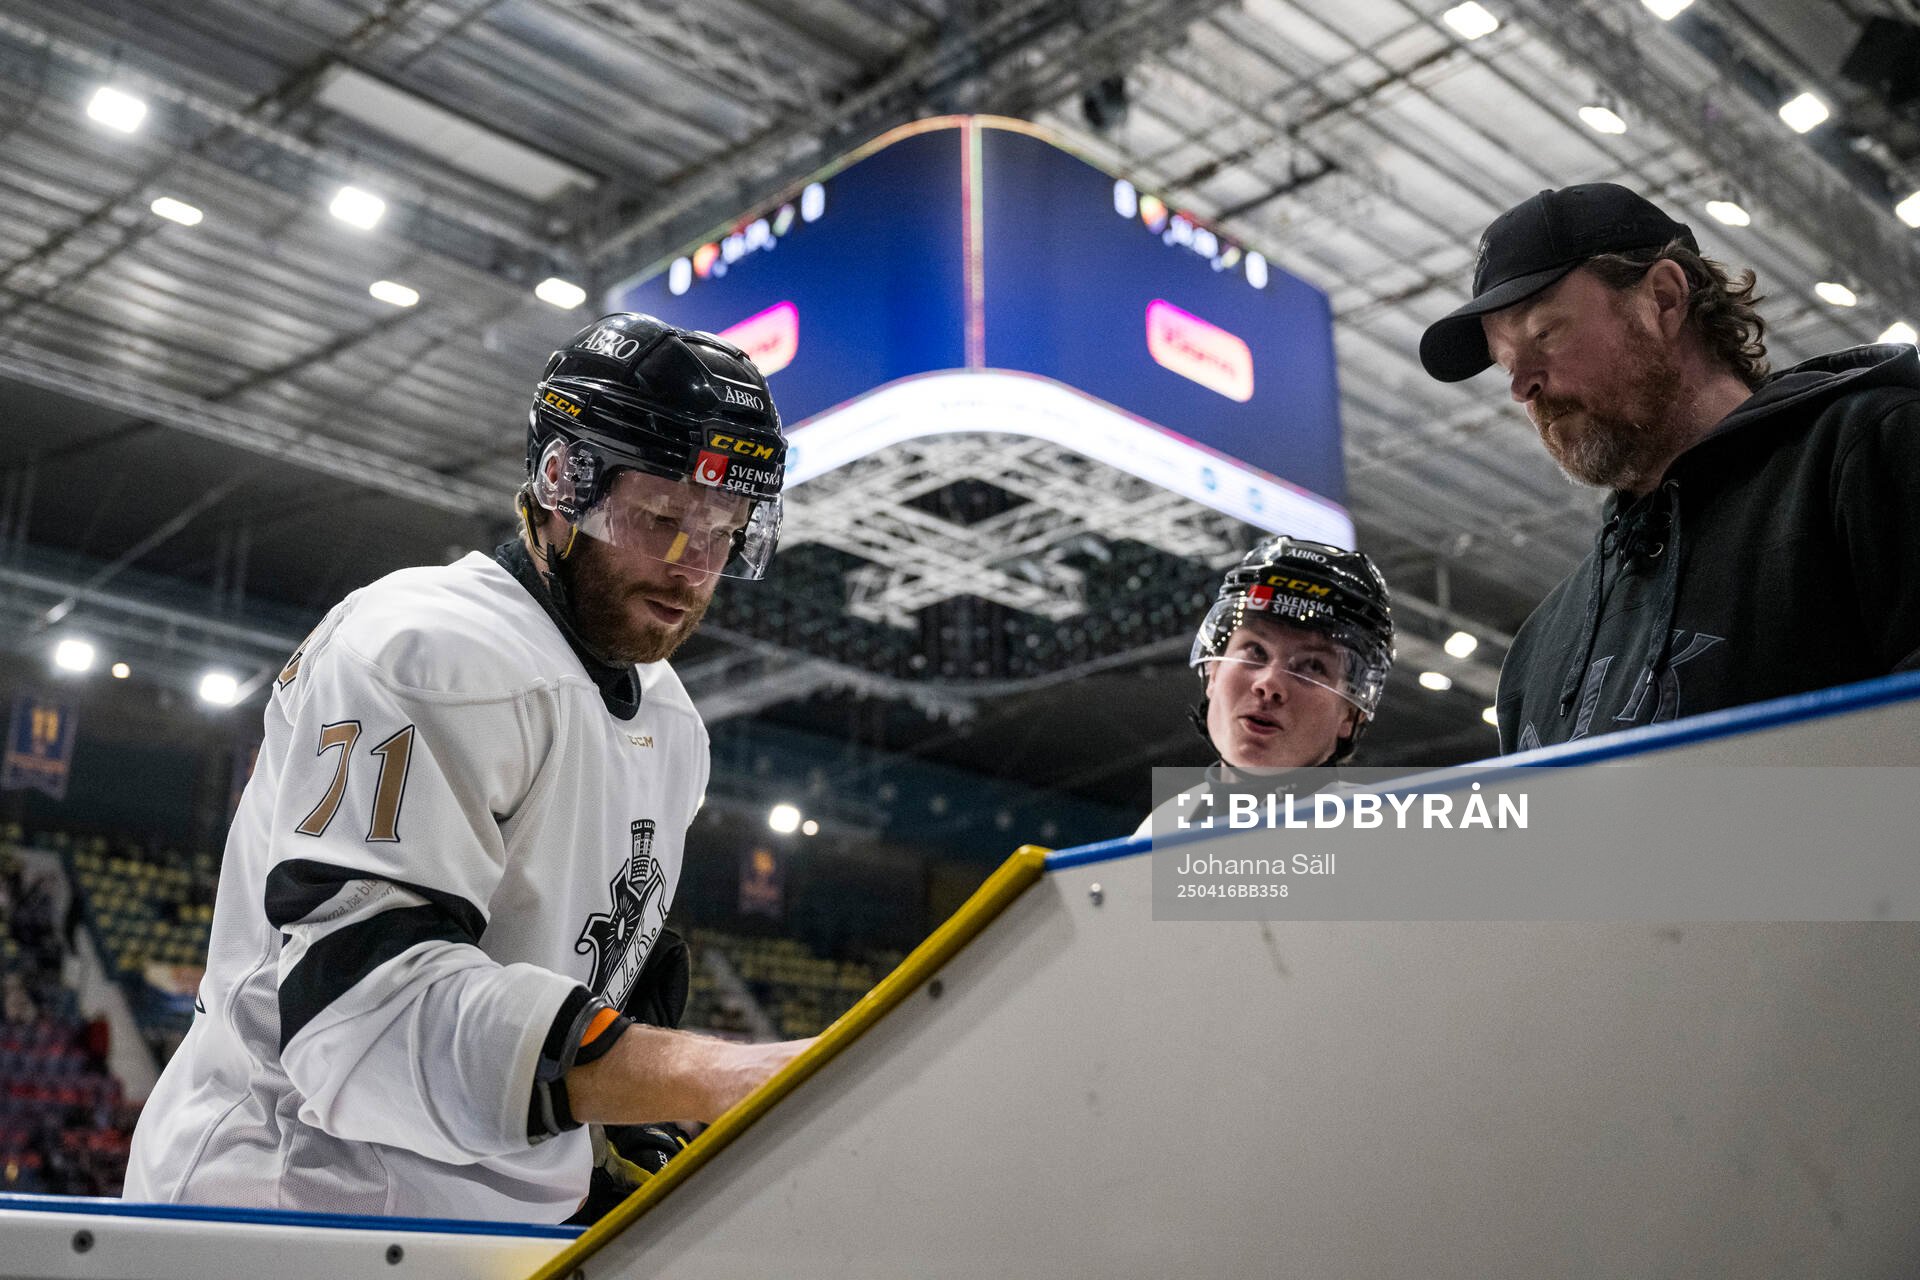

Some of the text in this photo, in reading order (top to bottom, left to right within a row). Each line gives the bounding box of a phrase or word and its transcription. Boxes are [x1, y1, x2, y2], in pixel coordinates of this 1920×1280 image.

[544, 391, 582, 418] CCM
[725, 385, 764, 411] ÅBRO
[709, 434, 776, 461] CCM
[729, 464, 781, 486] SVENSKA
[726, 479, 758, 497] SPEL
[558, 504, 575, 515] CCM
[1267, 575, 1333, 597] CCM
[1275, 593, 1335, 616] SVENSKA
[295, 719, 416, 843] 71
